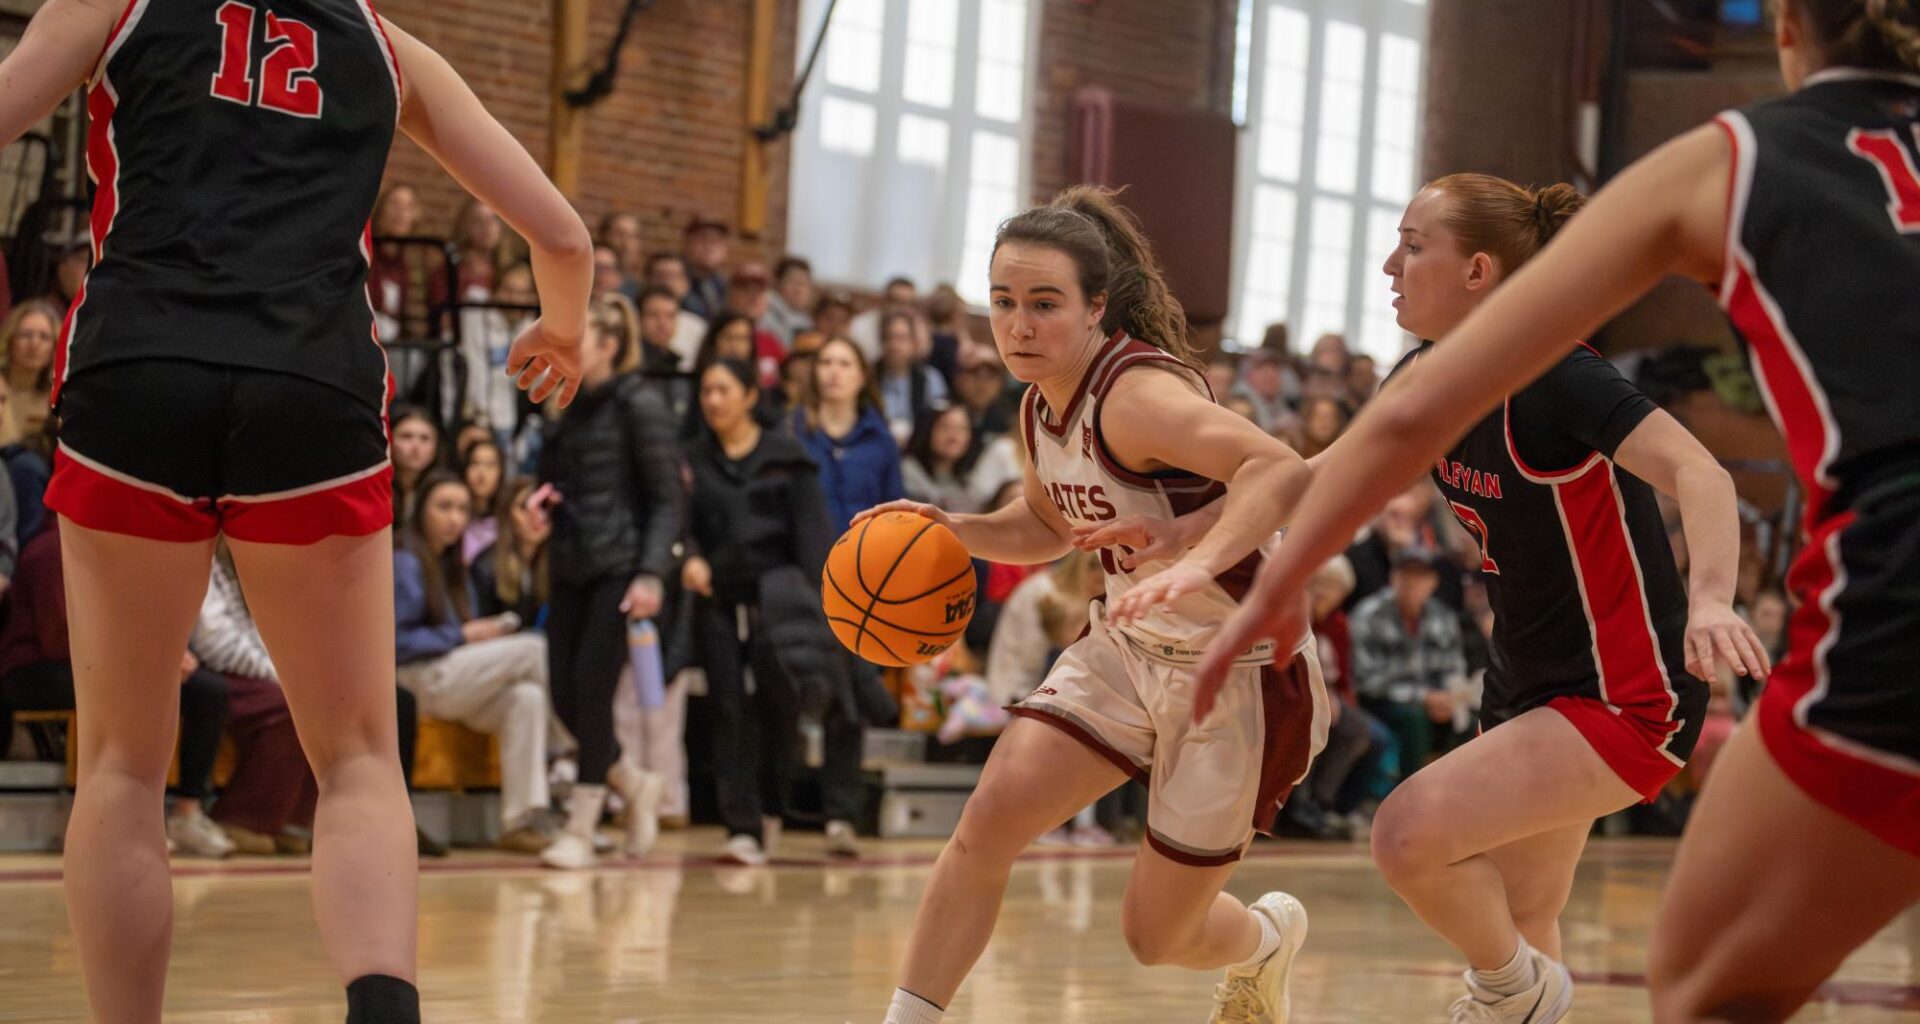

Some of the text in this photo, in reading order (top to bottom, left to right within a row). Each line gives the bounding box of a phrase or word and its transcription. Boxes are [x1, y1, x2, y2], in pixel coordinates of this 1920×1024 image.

[210, 0, 323, 119] 12
[1845, 126, 1920, 234] 1
[1043, 482, 1117, 522] ATES
[1437, 457, 1502, 499] LEYAN
